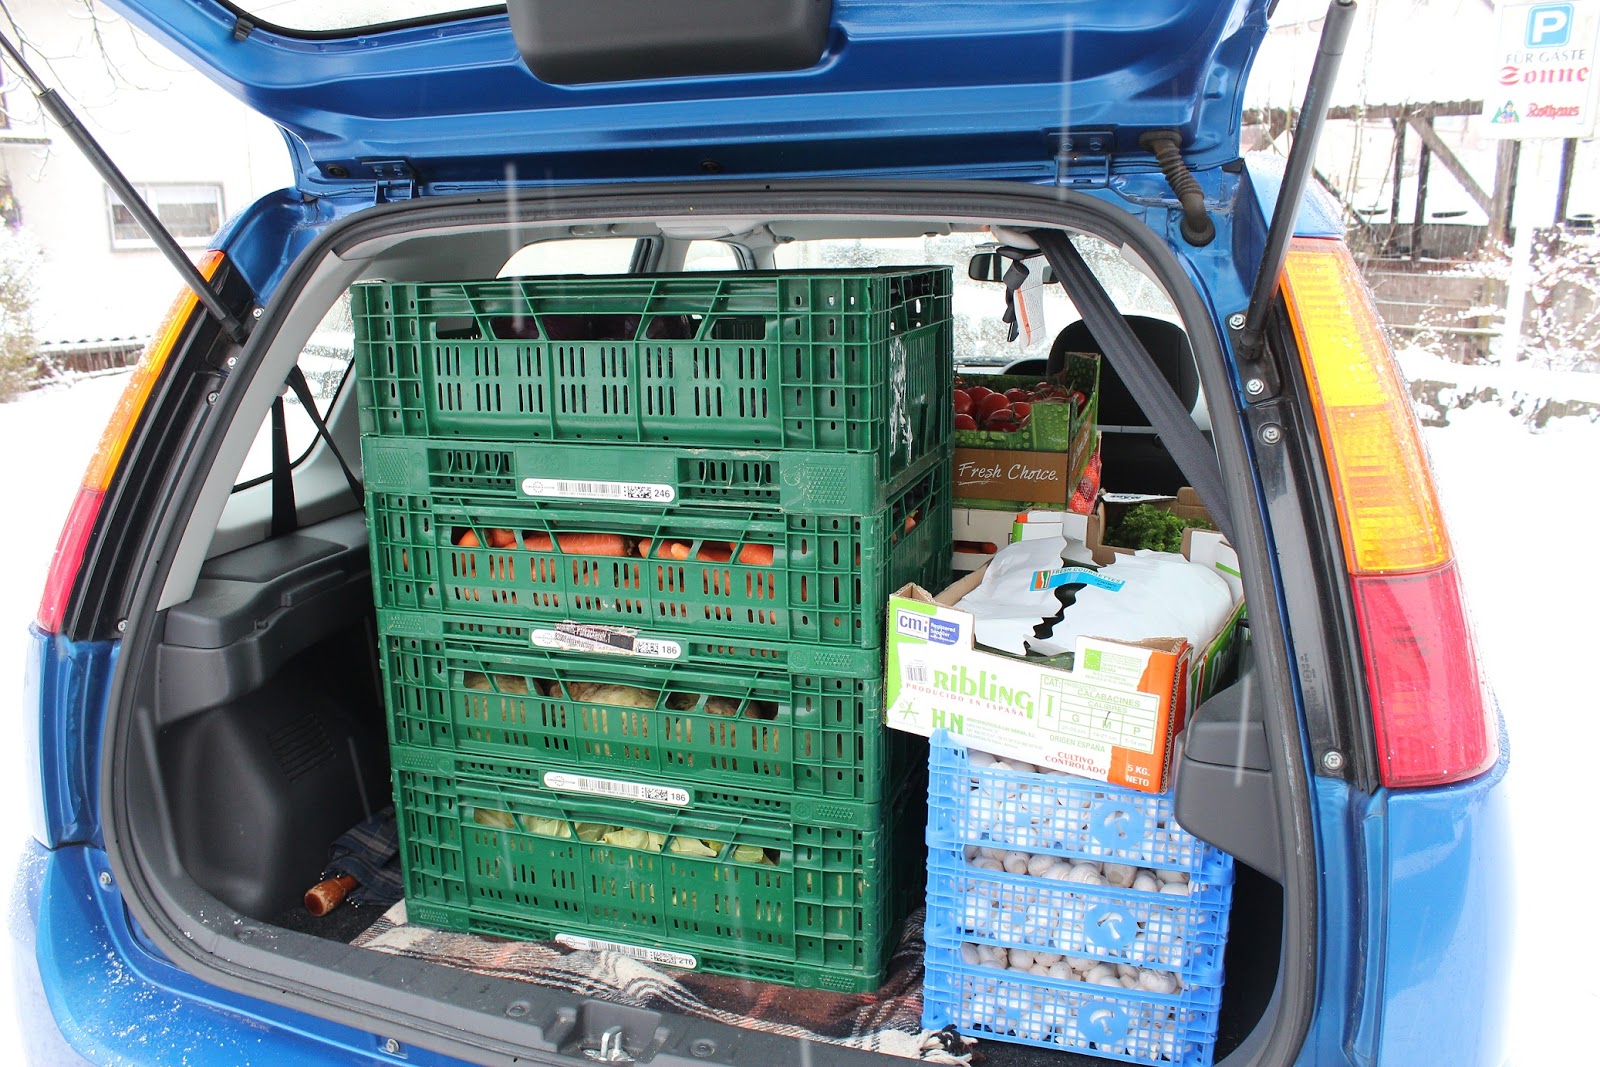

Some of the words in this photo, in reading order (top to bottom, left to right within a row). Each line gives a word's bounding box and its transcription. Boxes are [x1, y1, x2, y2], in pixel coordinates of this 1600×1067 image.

[1531, 10, 1567, 43] P
[958, 461, 1001, 478] Fresh
[655, 489, 671, 498] 246
[900, 615, 928, 633] cmi
[662, 646, 677, 654] 186
[1044, 676, 1061, 688] CAT:
[906, 682, 964, 702] PRODUCIDO
[969, 698, 981, 706] EN
[987, 703, 1024, 717] ESPAÑA
[1077, 690, 1141, 707] CALABACINES
[1088, 700, 1128, 713] CALIBRES
[1072, 714, 1079, 722] G
[1102, 719, 1112, 729] M
[1133, 727, 1141, 735] P
[1049, 734, 1076, 746] ORIGEN
[1077, 741, 1105, 753] ESPAÑA
[1044, 755, 1107, 775] CONTROLADO
[1057, 751, 1094, 766] CULTIVO
[1135, 766, 1150, 776] KG.
[1125, 774, 1150, 787] NETO
[671, 793, 686, 802] 186
[679, 958, 694, 966] 216
